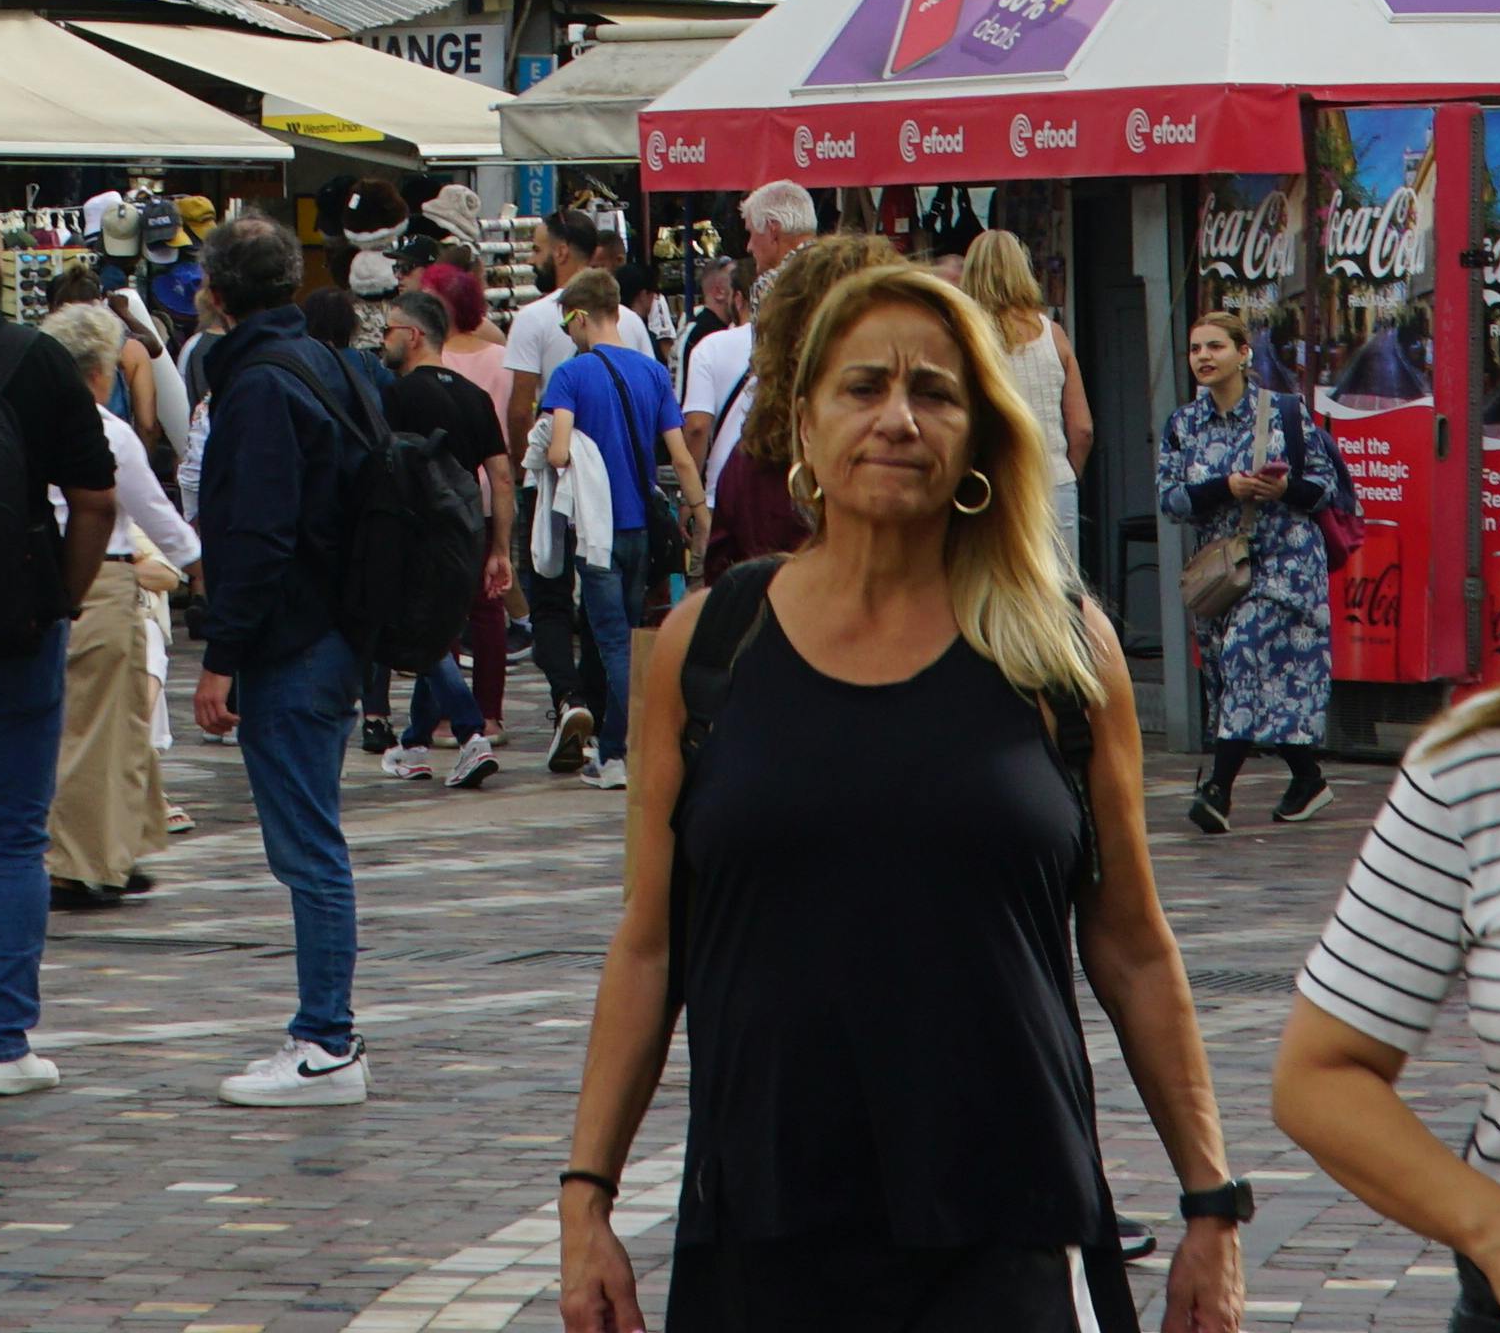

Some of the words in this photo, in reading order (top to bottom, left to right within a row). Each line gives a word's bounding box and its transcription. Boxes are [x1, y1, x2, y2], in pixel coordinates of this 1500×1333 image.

[973, 14, 1021, 50] deals
[923, 125, 963, 154] efood
[1034, 120, 1077, 149] efood
[1152, 115, 1196, 144] efood
[667, 137, 705, 164] efood
[816, 131, 855, 159] efood
[1338, 437, 1364, 454] Feel
[1367, 437, 1390, 454] the
[1347, 461, 1366, 478] eal
[1369, 461, 1409, 482] Magic
